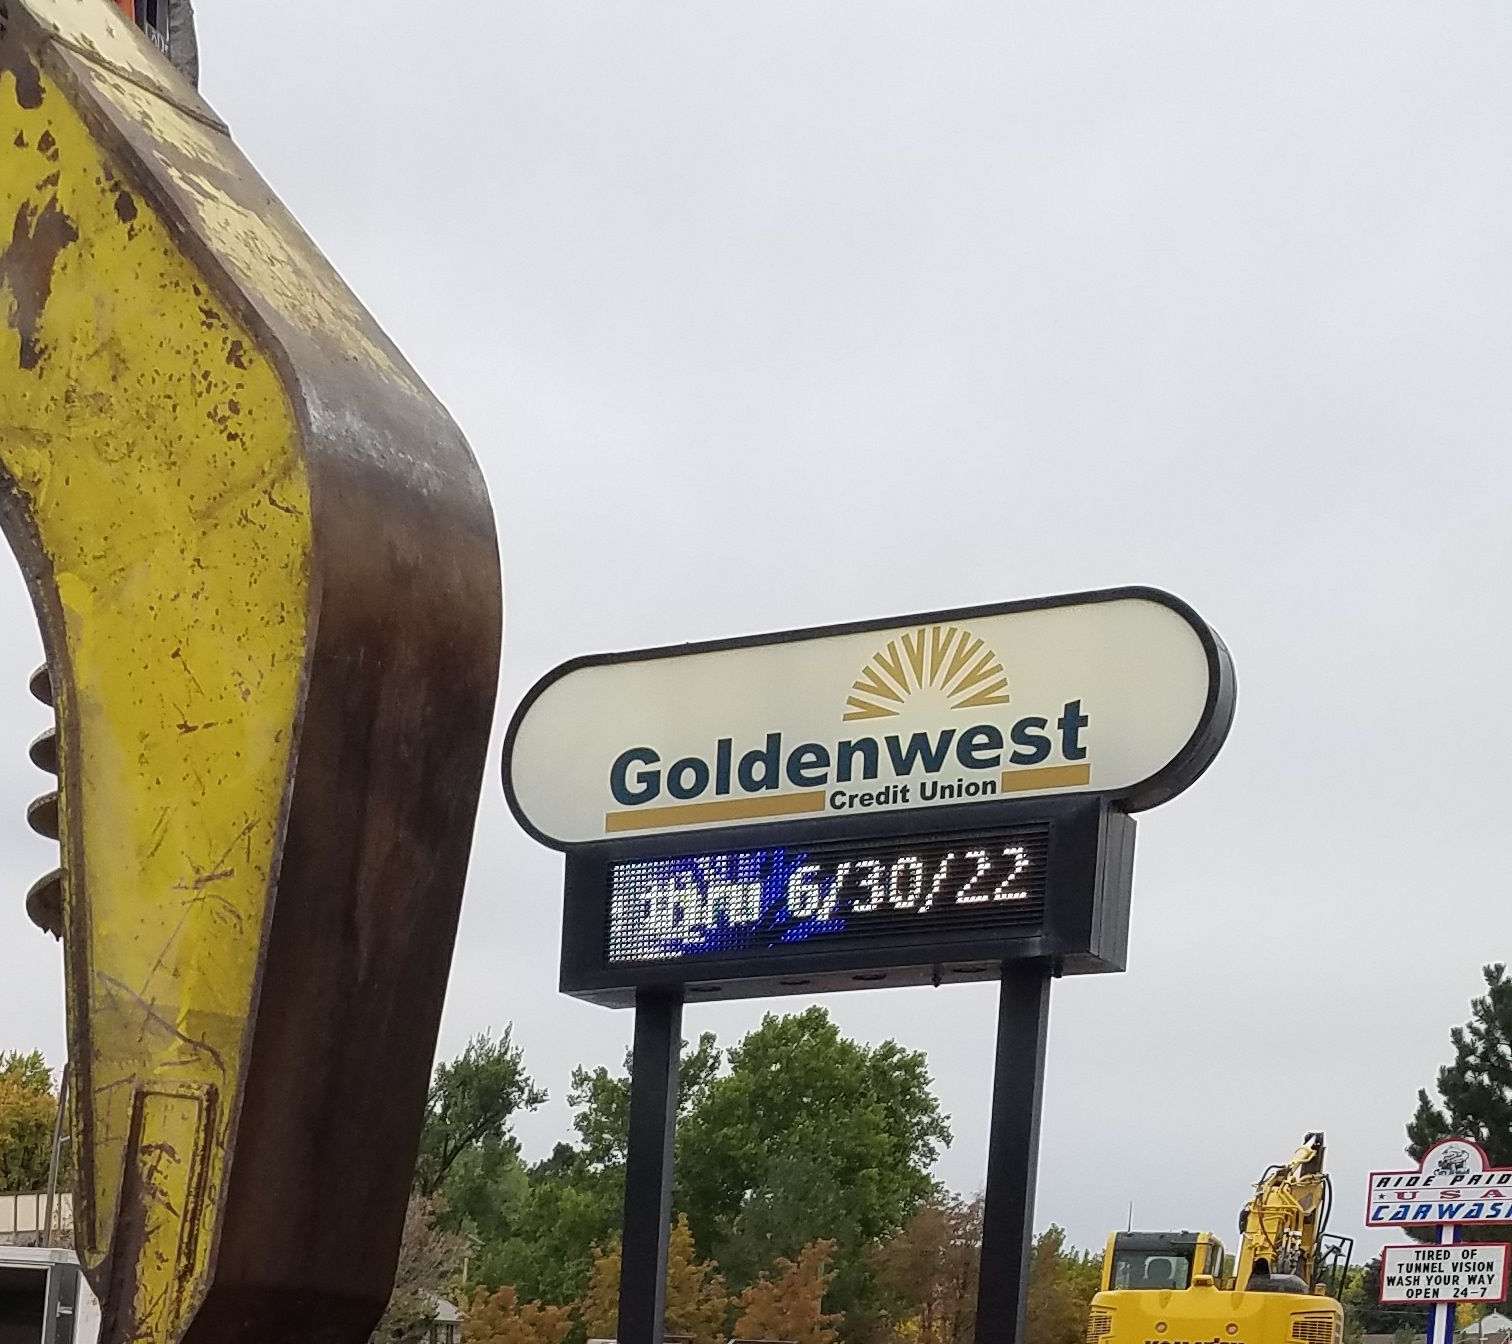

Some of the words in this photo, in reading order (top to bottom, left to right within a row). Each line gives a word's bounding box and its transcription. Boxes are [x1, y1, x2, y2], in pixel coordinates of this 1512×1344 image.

[609, 699, 1089, 806] Goldenwest
[829, 784, 910, 810] Credit
[920, 777, 998, 801] Union
[787, 846, 1029, 921] 6/30/22
[1376, 1176, 1435, 1188] RIDE
[1449, 1173, 1512, 1186] PRID
[1414, 1250, 1450, 1260] TIRED
[1461, 1249, 1477, 1259] OF
[1397, 1263, 1444, 1273] TUNNEL
[1451, 1262, 1494, 1273] VISION
[1387, 1275, 1420, 1286] WASH
[1426, 1275, 1460, 1286] YOUR
[1467, 1274, 1495, 1285] WAY
[1406, 1288, 1439, 1298] OPEN
[1452, 1287, 1487, 1298] 24-7
